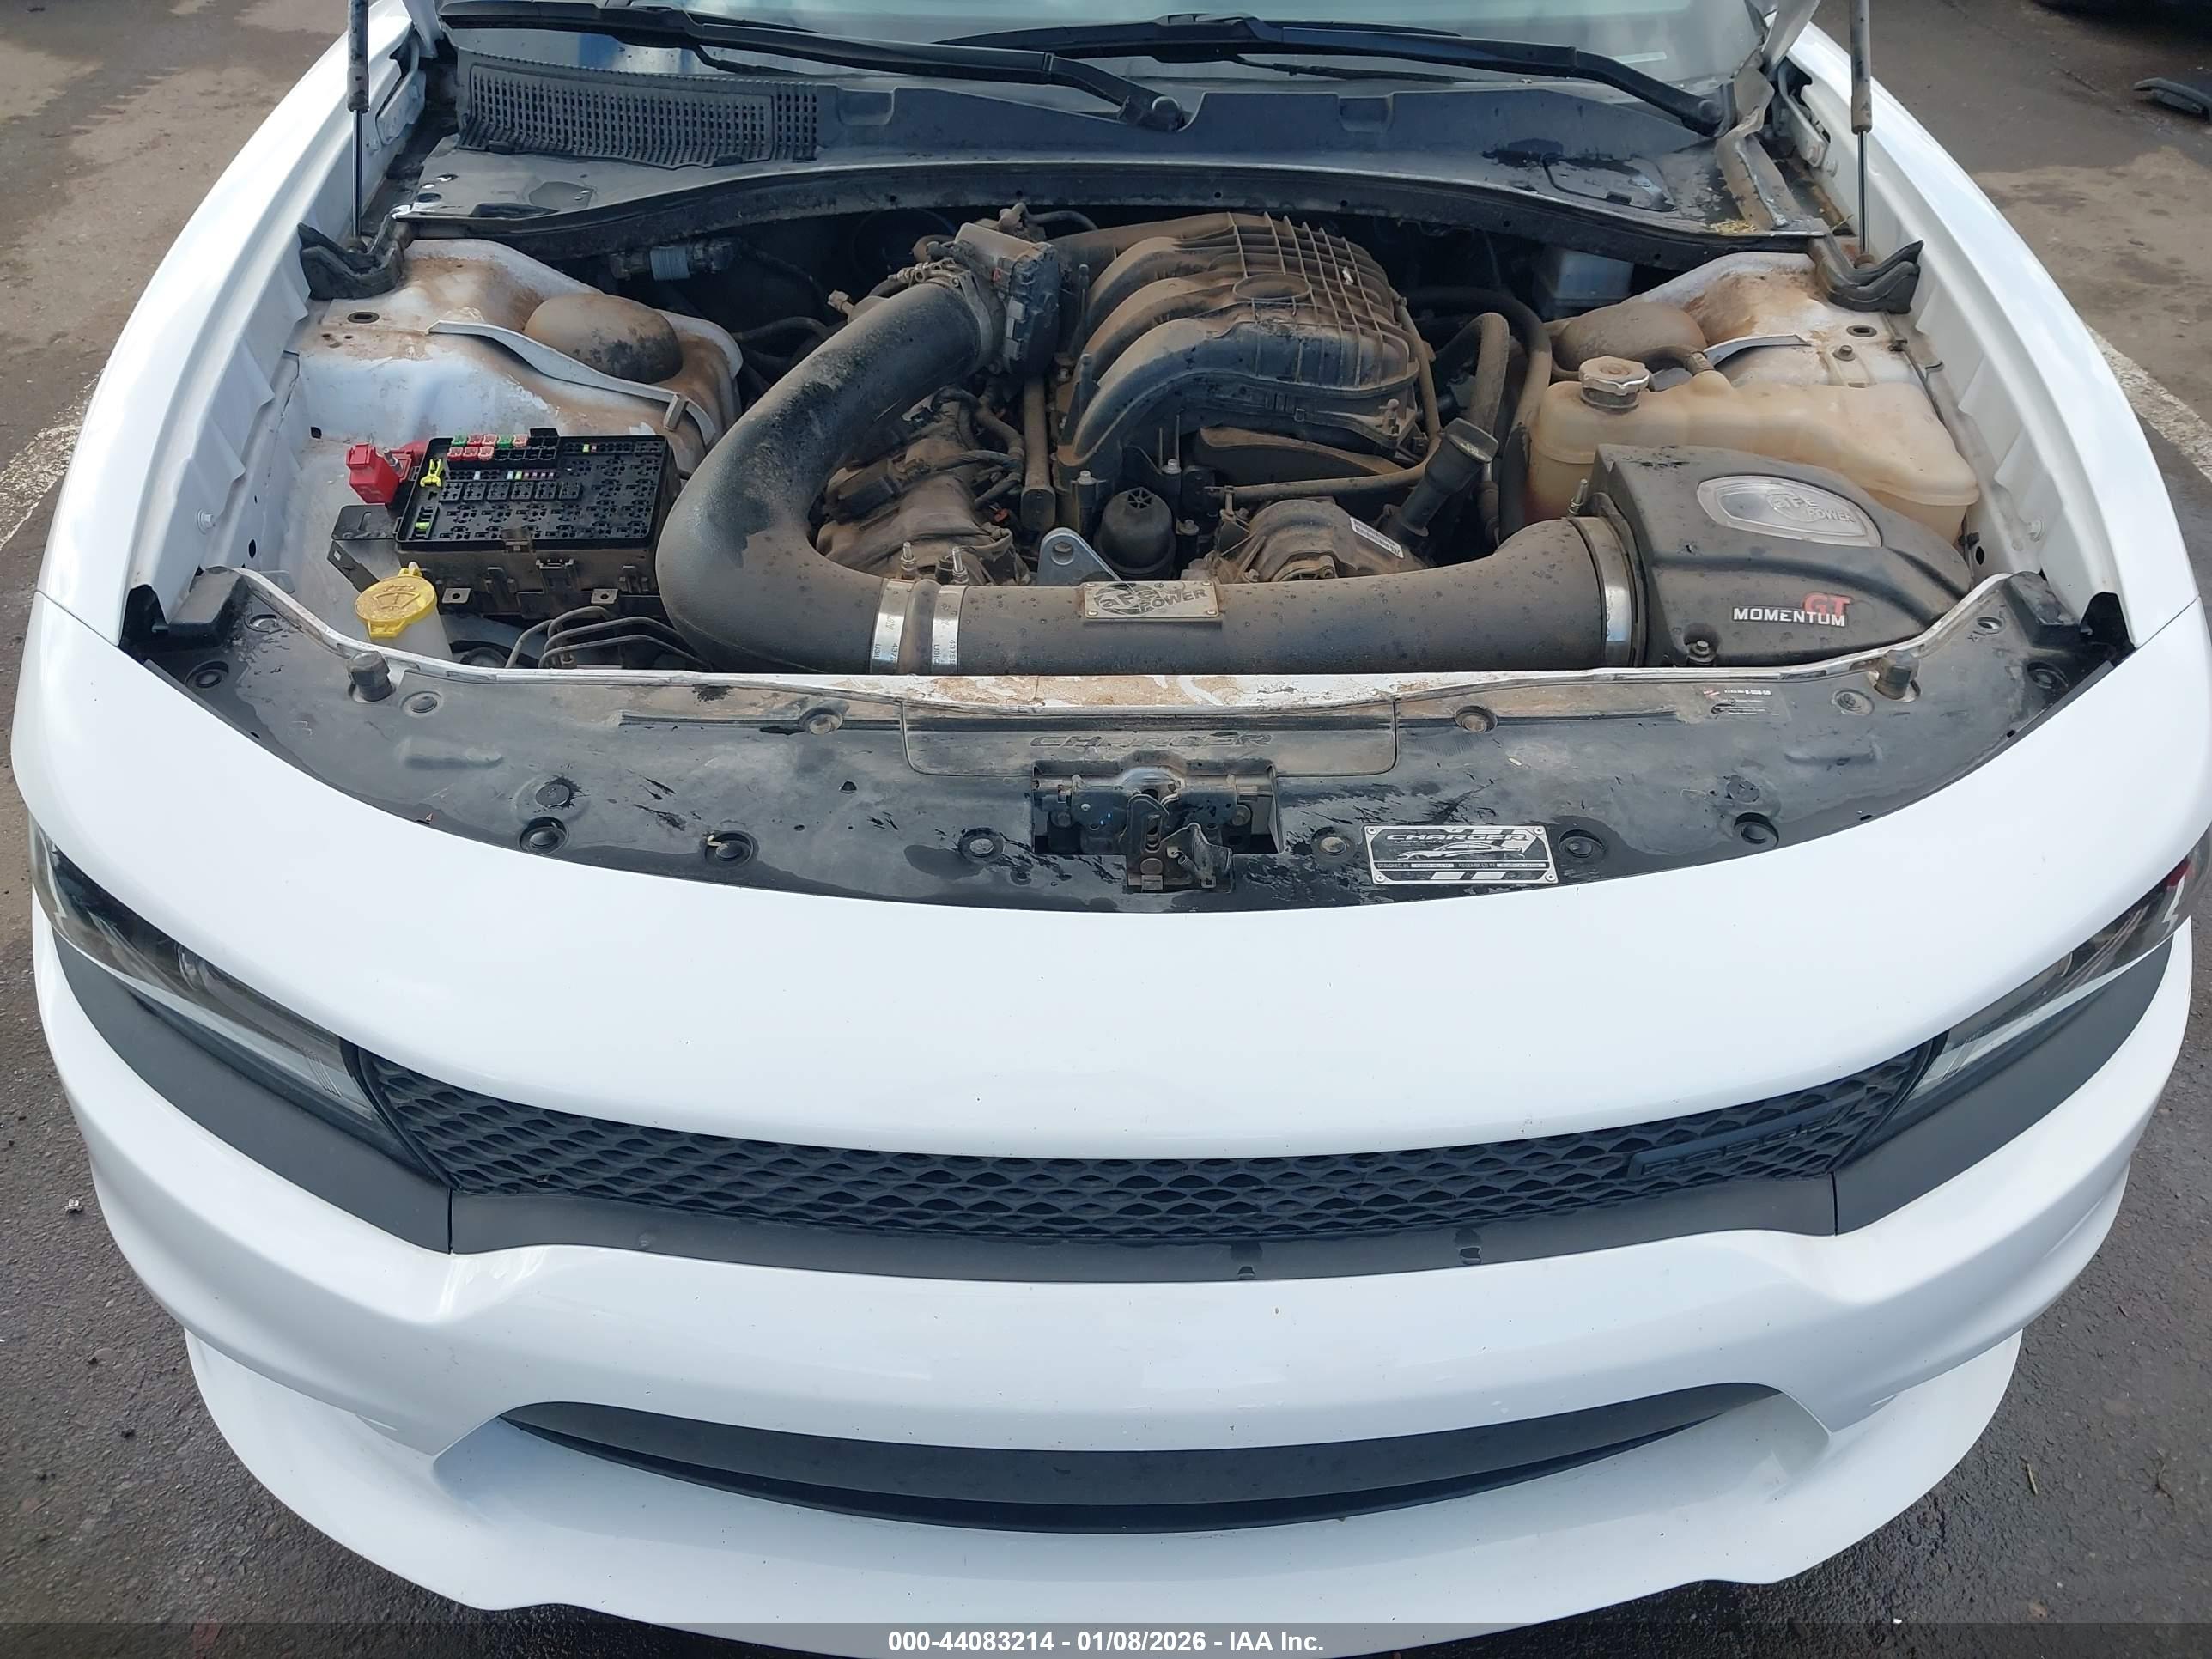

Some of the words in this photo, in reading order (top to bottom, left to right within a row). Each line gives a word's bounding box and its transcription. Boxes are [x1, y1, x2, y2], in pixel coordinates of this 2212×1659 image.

[1808, 507, 1856, 523] POWER
[1138, 588, 1208, 612] POWER
[1804, 592, 1850, 618] GT
[1733, 607, 1846, 627] MOMENTUM
[1030, 734, 1272, 747] CHARGER
